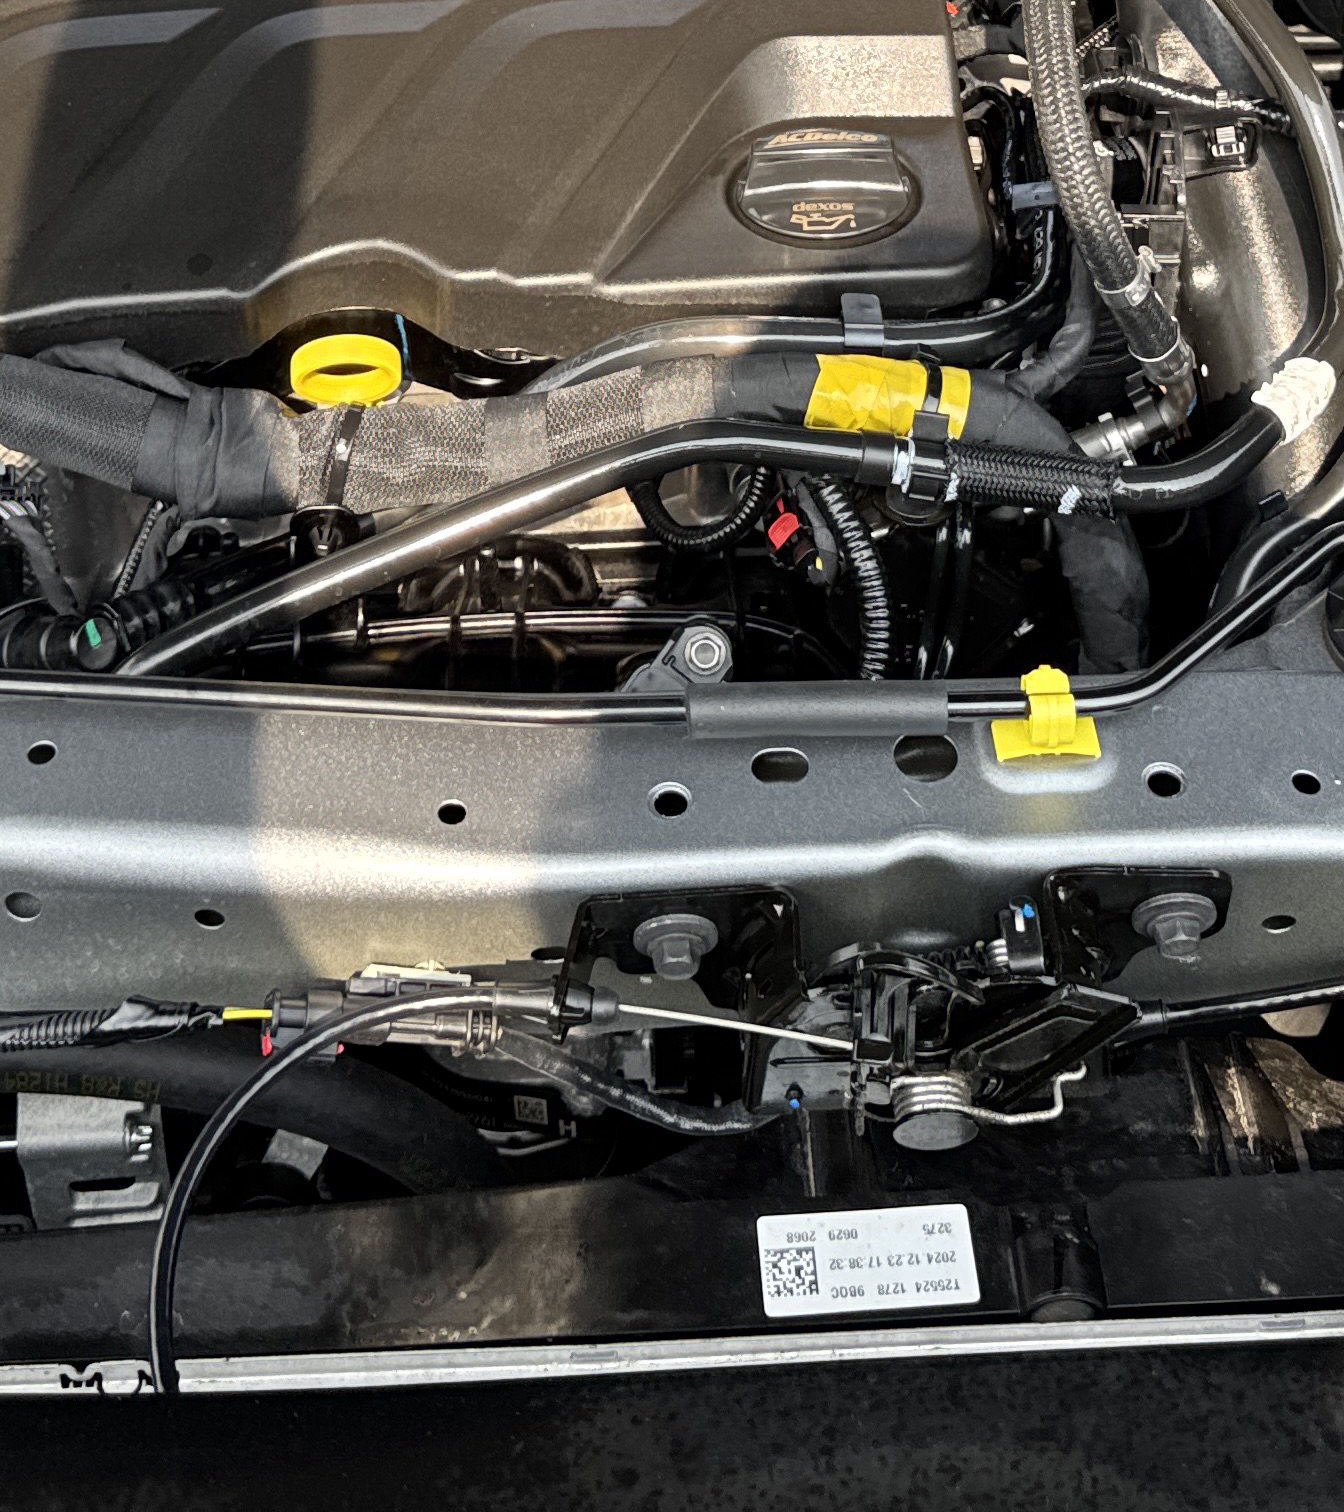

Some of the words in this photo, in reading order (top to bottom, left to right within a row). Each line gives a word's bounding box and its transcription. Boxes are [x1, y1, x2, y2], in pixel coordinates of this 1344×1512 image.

[766, 131, 878, 146] ACDelco
[792, 201, 855, 212] dexos
[922, 1222, 952, 1234] 3275
[786, 1231, 816, 1243] 2068
[877, 1282, 907, 1296] 1278
